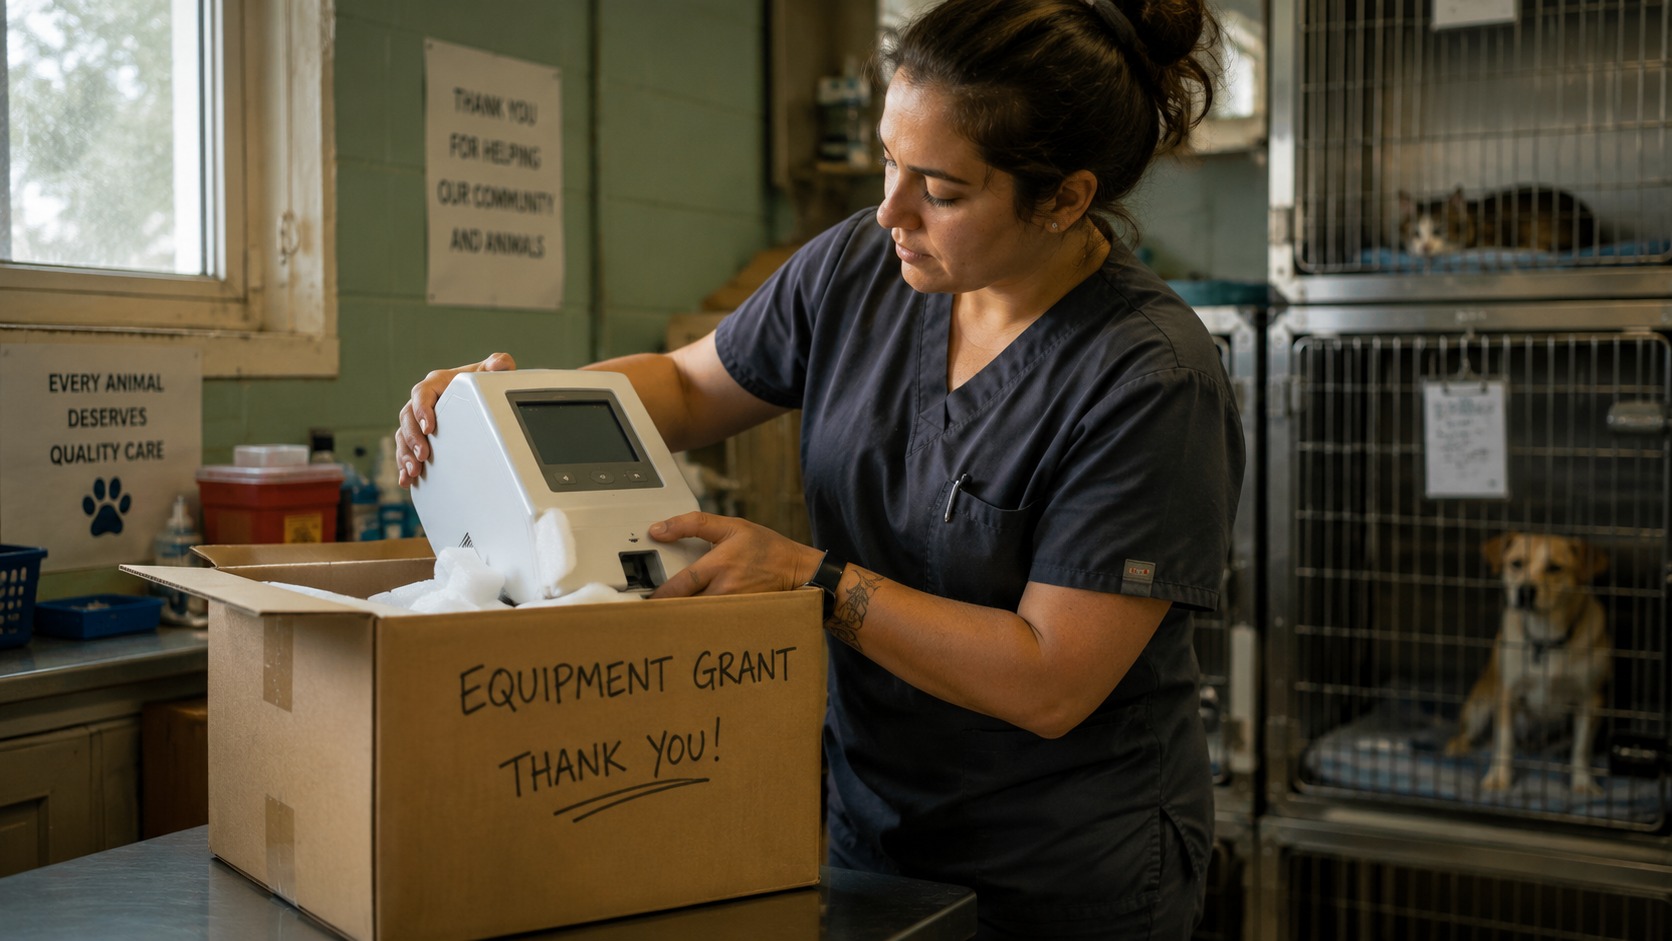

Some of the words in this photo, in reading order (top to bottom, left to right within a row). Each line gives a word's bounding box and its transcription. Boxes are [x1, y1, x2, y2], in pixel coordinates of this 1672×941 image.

[453, 87, 504, 118] THANK
[508, 98, 538, 127] YOU
[450, 132, 480, 161] FOR
[482, 138, 541, 170] HELPING
[437, 179, 471, 206] OUR
[473, 183, 554, 216] COMMUNITY
[451, 228, 482, 254] AND
[484, 230, 545, 259] ANIMALS
[49, 373, 101, 393] EVERY
[105, 373, 165, 393] ANIMAL
[68, 407, 147, 428] DESERVES
[50, 443, 121, 466] QUALITY
[125, 440, 165, 461] CARE
[460, 655, 673, 715] EQUIPMENT
[693, 647, 797, 691] GRANT
[499, 740, 627, 797] THANK
[646, 716, 721, 779] YOU!
